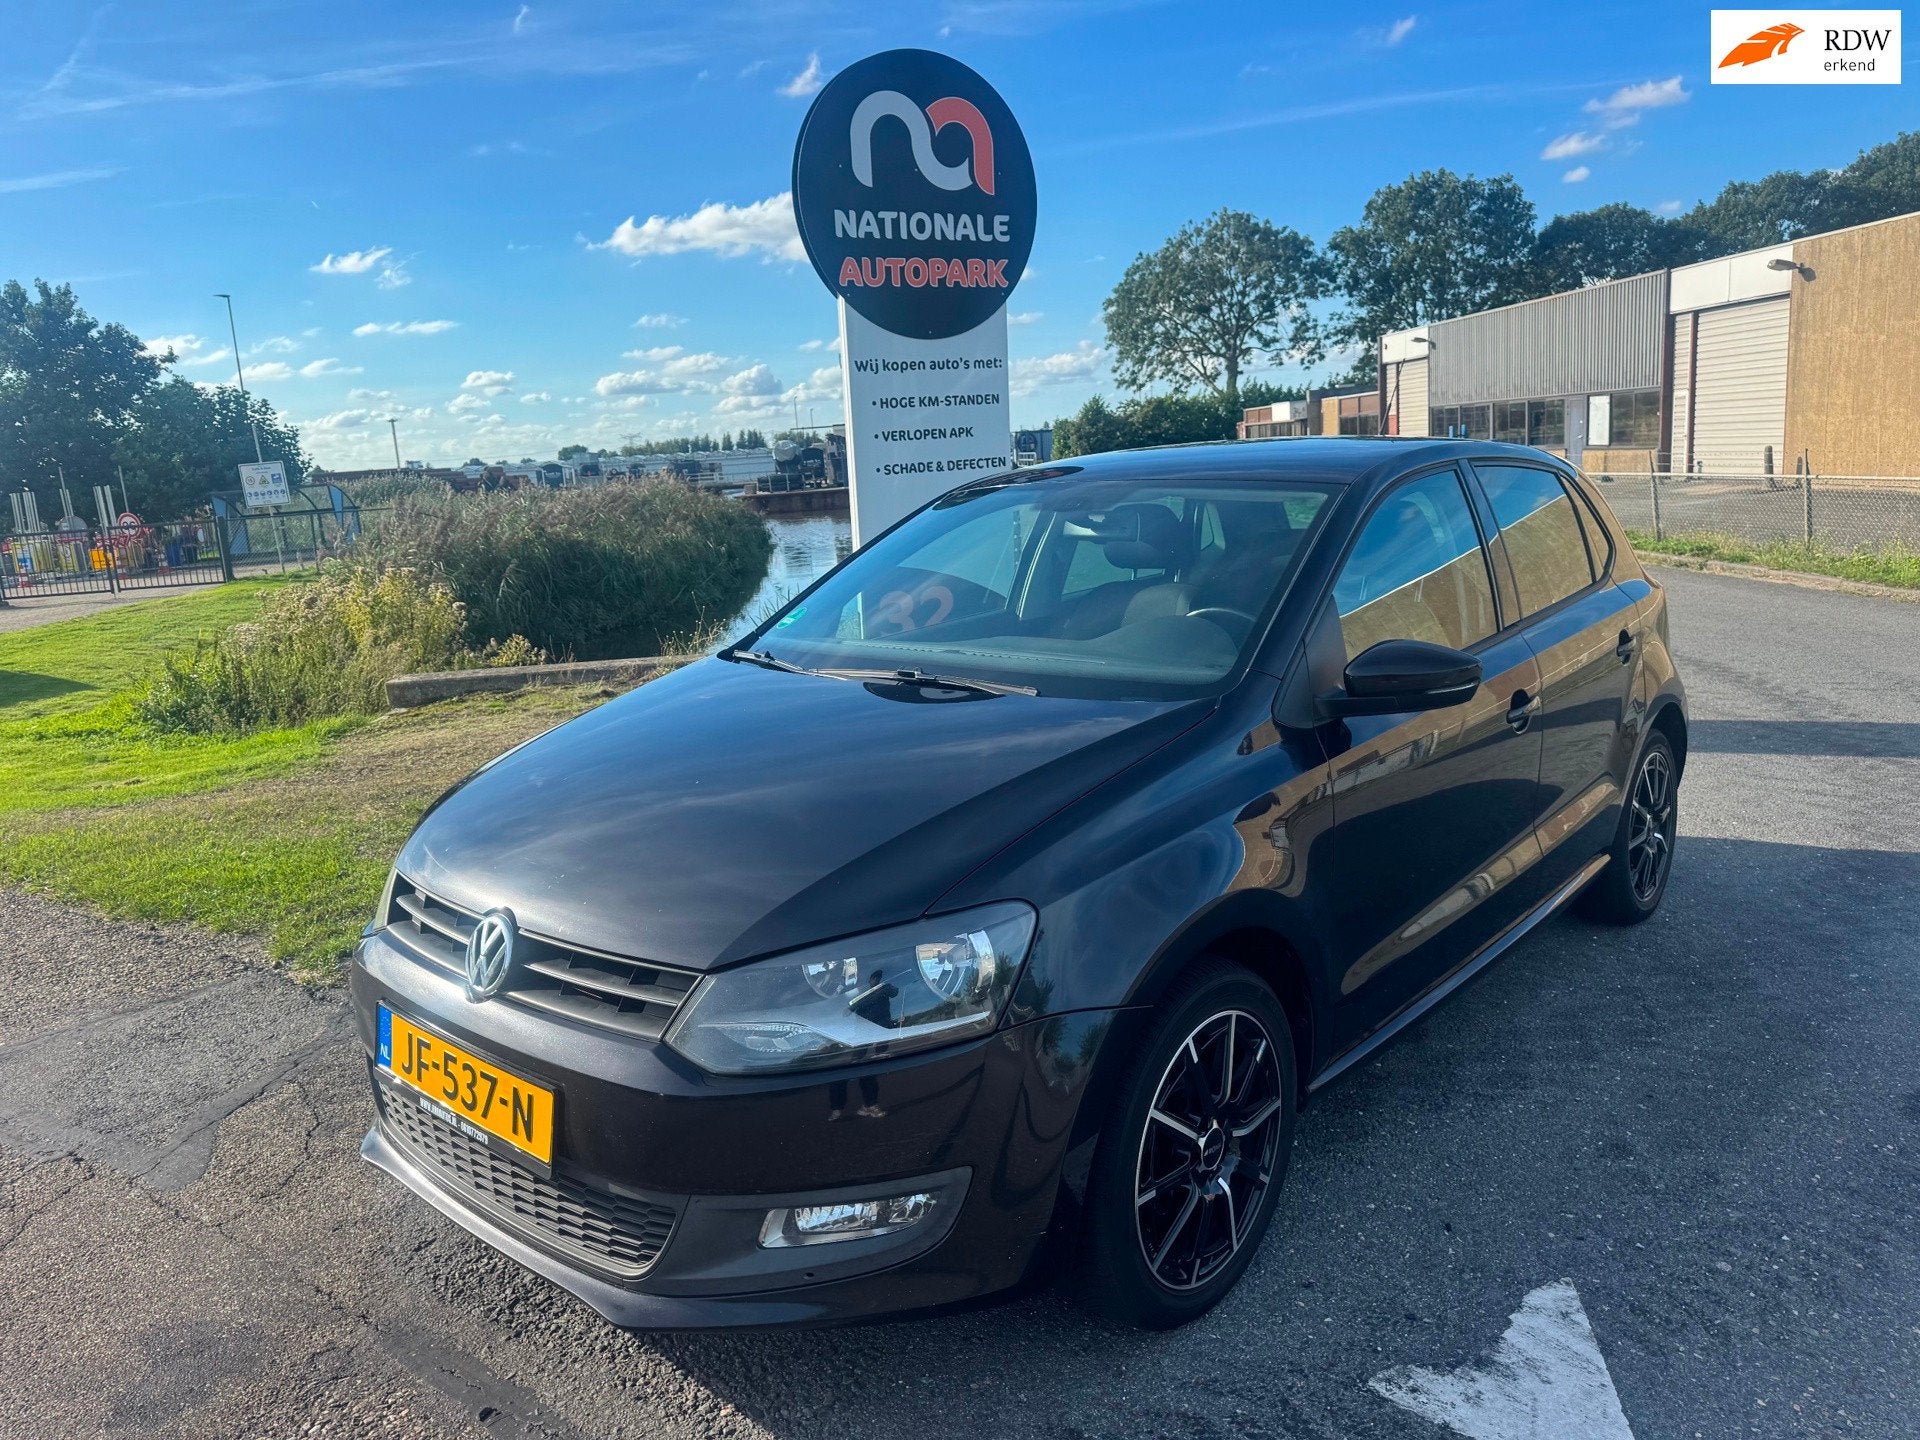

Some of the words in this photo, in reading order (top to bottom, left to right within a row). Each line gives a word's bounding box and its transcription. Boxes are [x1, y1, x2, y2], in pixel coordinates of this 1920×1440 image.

[834, 209, 1010, 242] NATIONALE
[839, 256, 1009, 288] AUTOPARK
[854, 358, 879, 374] Wij
[882, 358, 926, 373] kopen
[929, 357, 970, 371] auto's
[973, 357, 1003, 369] met:
[880, 396, 916, 409] HOGE
[919, 393, 1000, 408] KM-STANDEN
[882, 428, 947, 442] VERLOPEN
[950, 426, 974, 438] APK
[884, 461, 934, 475] SCHADE
[935, 460, 944, 472] &
[947, 456, 1007, 471] DEFECTEN
[380, 1042, 390, 1060] NL
[402, 1031, 533, 1143] JF-537-N
